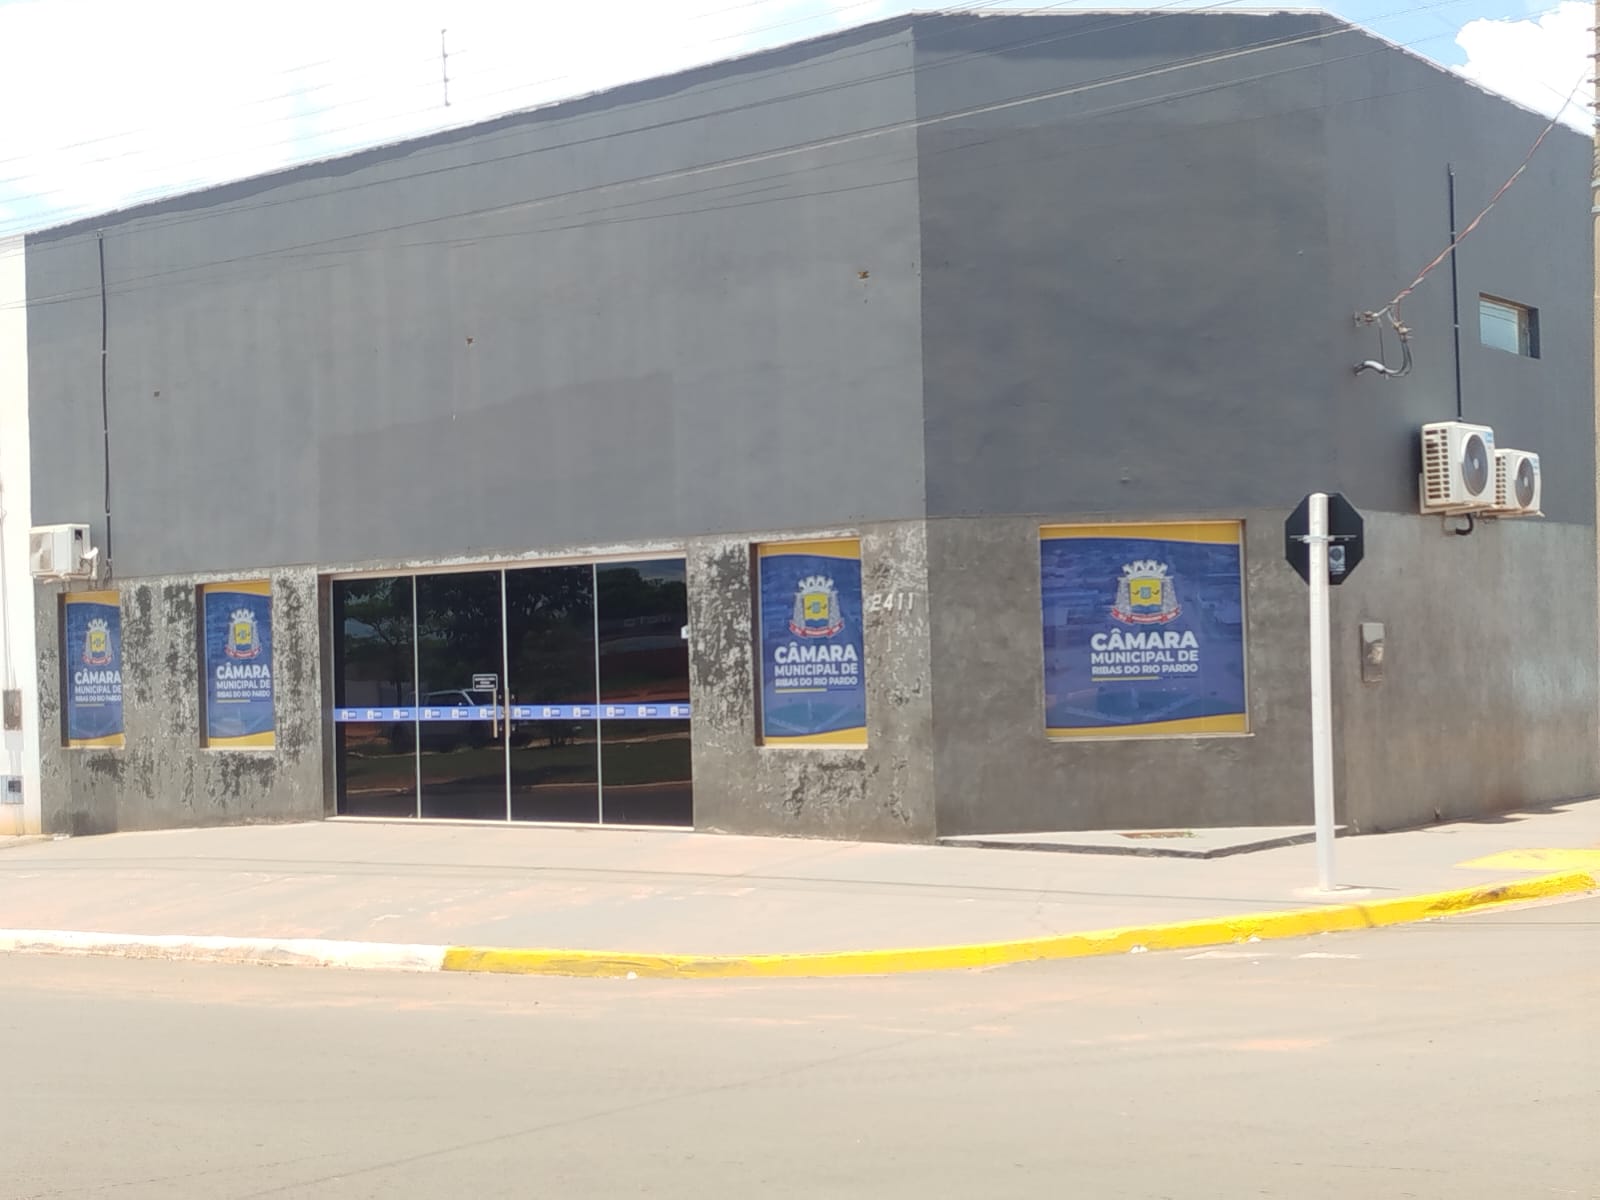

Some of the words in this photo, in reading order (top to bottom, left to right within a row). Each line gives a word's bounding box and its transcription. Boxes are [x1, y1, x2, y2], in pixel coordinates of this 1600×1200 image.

[868, 592, 914, 612] 2411
[1091, 628, 1199, 650] CÂMARA
[774, 642, 858, 664] CÂMARA
[1092, 651, 1175, 664] MUNICIPAL
[1178, 650, 1199, 662] DE
[75, 668, 122, 684] CÂMARA
[216, 662, 270, 679] CÂMARA
[775, 664, 838, 676] MUNICIPAL
[841, 663, 858, 674] DE
[1092, 665, 1123, 675] RIBAS
[1124, 664, 1140, 674] DO
[1142, 664, 1160, 673] RIO
[1162, 664, 1198, 673] PARDO
[216, 680, 258, 690] MUNICIPAL
[260, 680, 270, 689] DE
[775, 678, 799, 687] RIBAS
[800, 677, 812, 686] DO
[813, 677, 828, 686] RIO
[829, 676, 858, 686] PARDO
[75, 685, 111, 694] MUNICIPAL
[112, 685, 122, 693] DE
